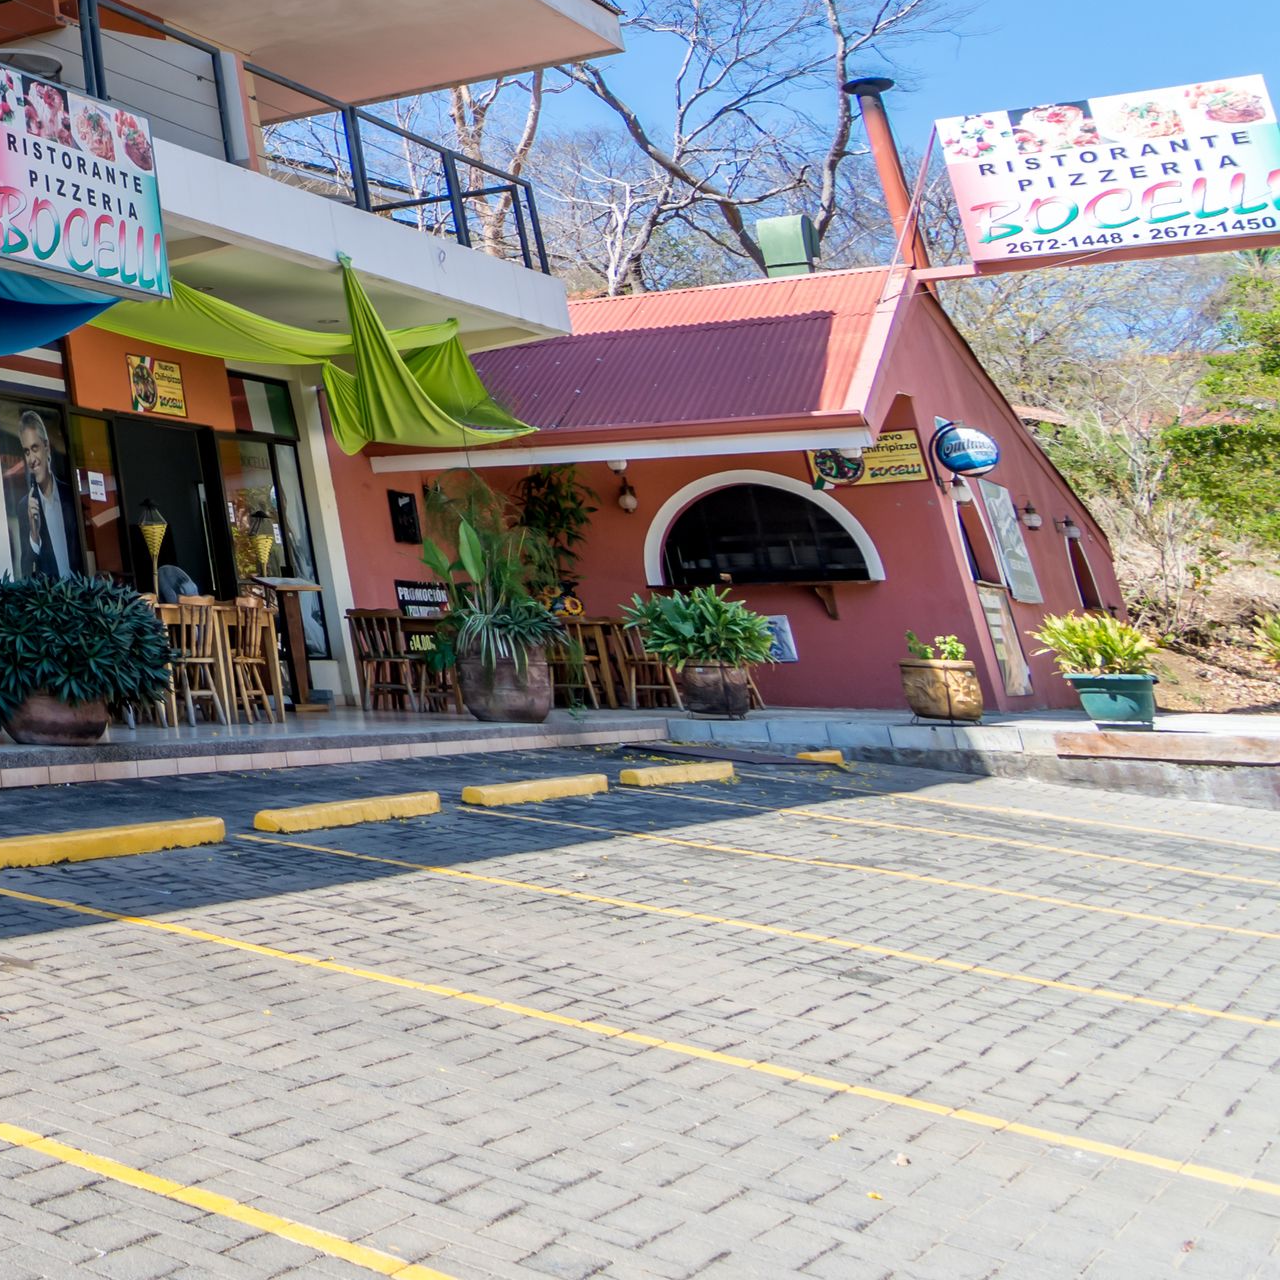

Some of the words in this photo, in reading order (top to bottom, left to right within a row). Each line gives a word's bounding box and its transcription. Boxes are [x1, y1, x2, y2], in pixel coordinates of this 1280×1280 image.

[6, 133, 143, 195] RISTORANTE
[978, 131, 1252, 176] RISTORANTE
[1018, 154, 1240, 192] PIZZERIA
[29, 170, 138, 220] PIZZERIA
[1006, 232, 1124, 255] 2672-1448
[1149, 216, 1277, 241] 2672-1450
[876, 433, 903, 442] ueva
[868, 463, 922, 478] BOCELLI
[397, 586, 448, 603] PROMOCIÓN
